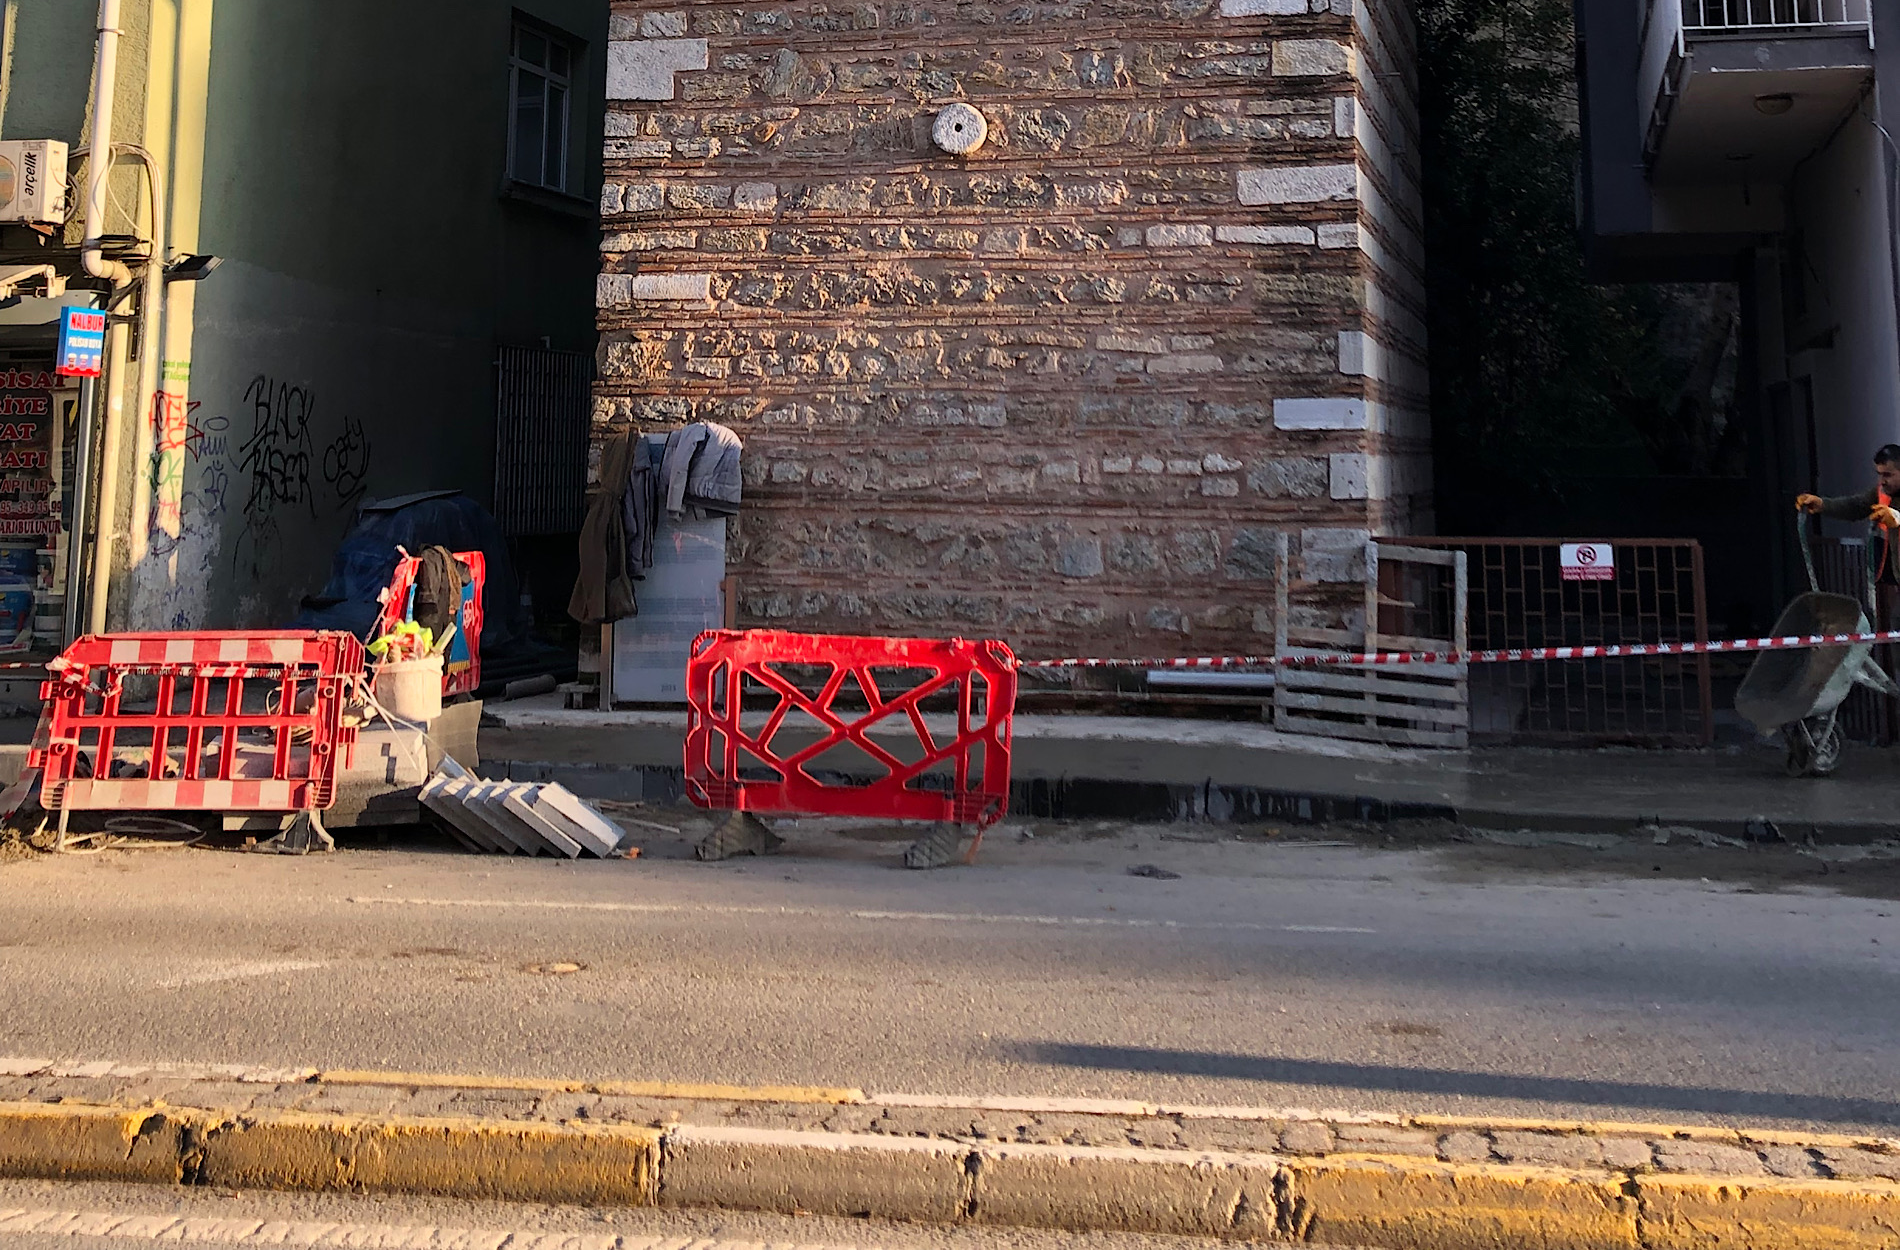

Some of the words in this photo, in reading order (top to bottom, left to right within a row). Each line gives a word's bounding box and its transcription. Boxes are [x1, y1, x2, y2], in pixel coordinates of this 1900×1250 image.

[24, 151, 38, 196] arçelik
[69, 312, 105, 332] NALBUR
[0, 394, 47, 415] İYE
[0, 423, 36, 440] AT
[0, 451, 47, 468] ATI
[0, 478, 49, 493] APILIR
[17, 519, 61, 534] BULUNUR
